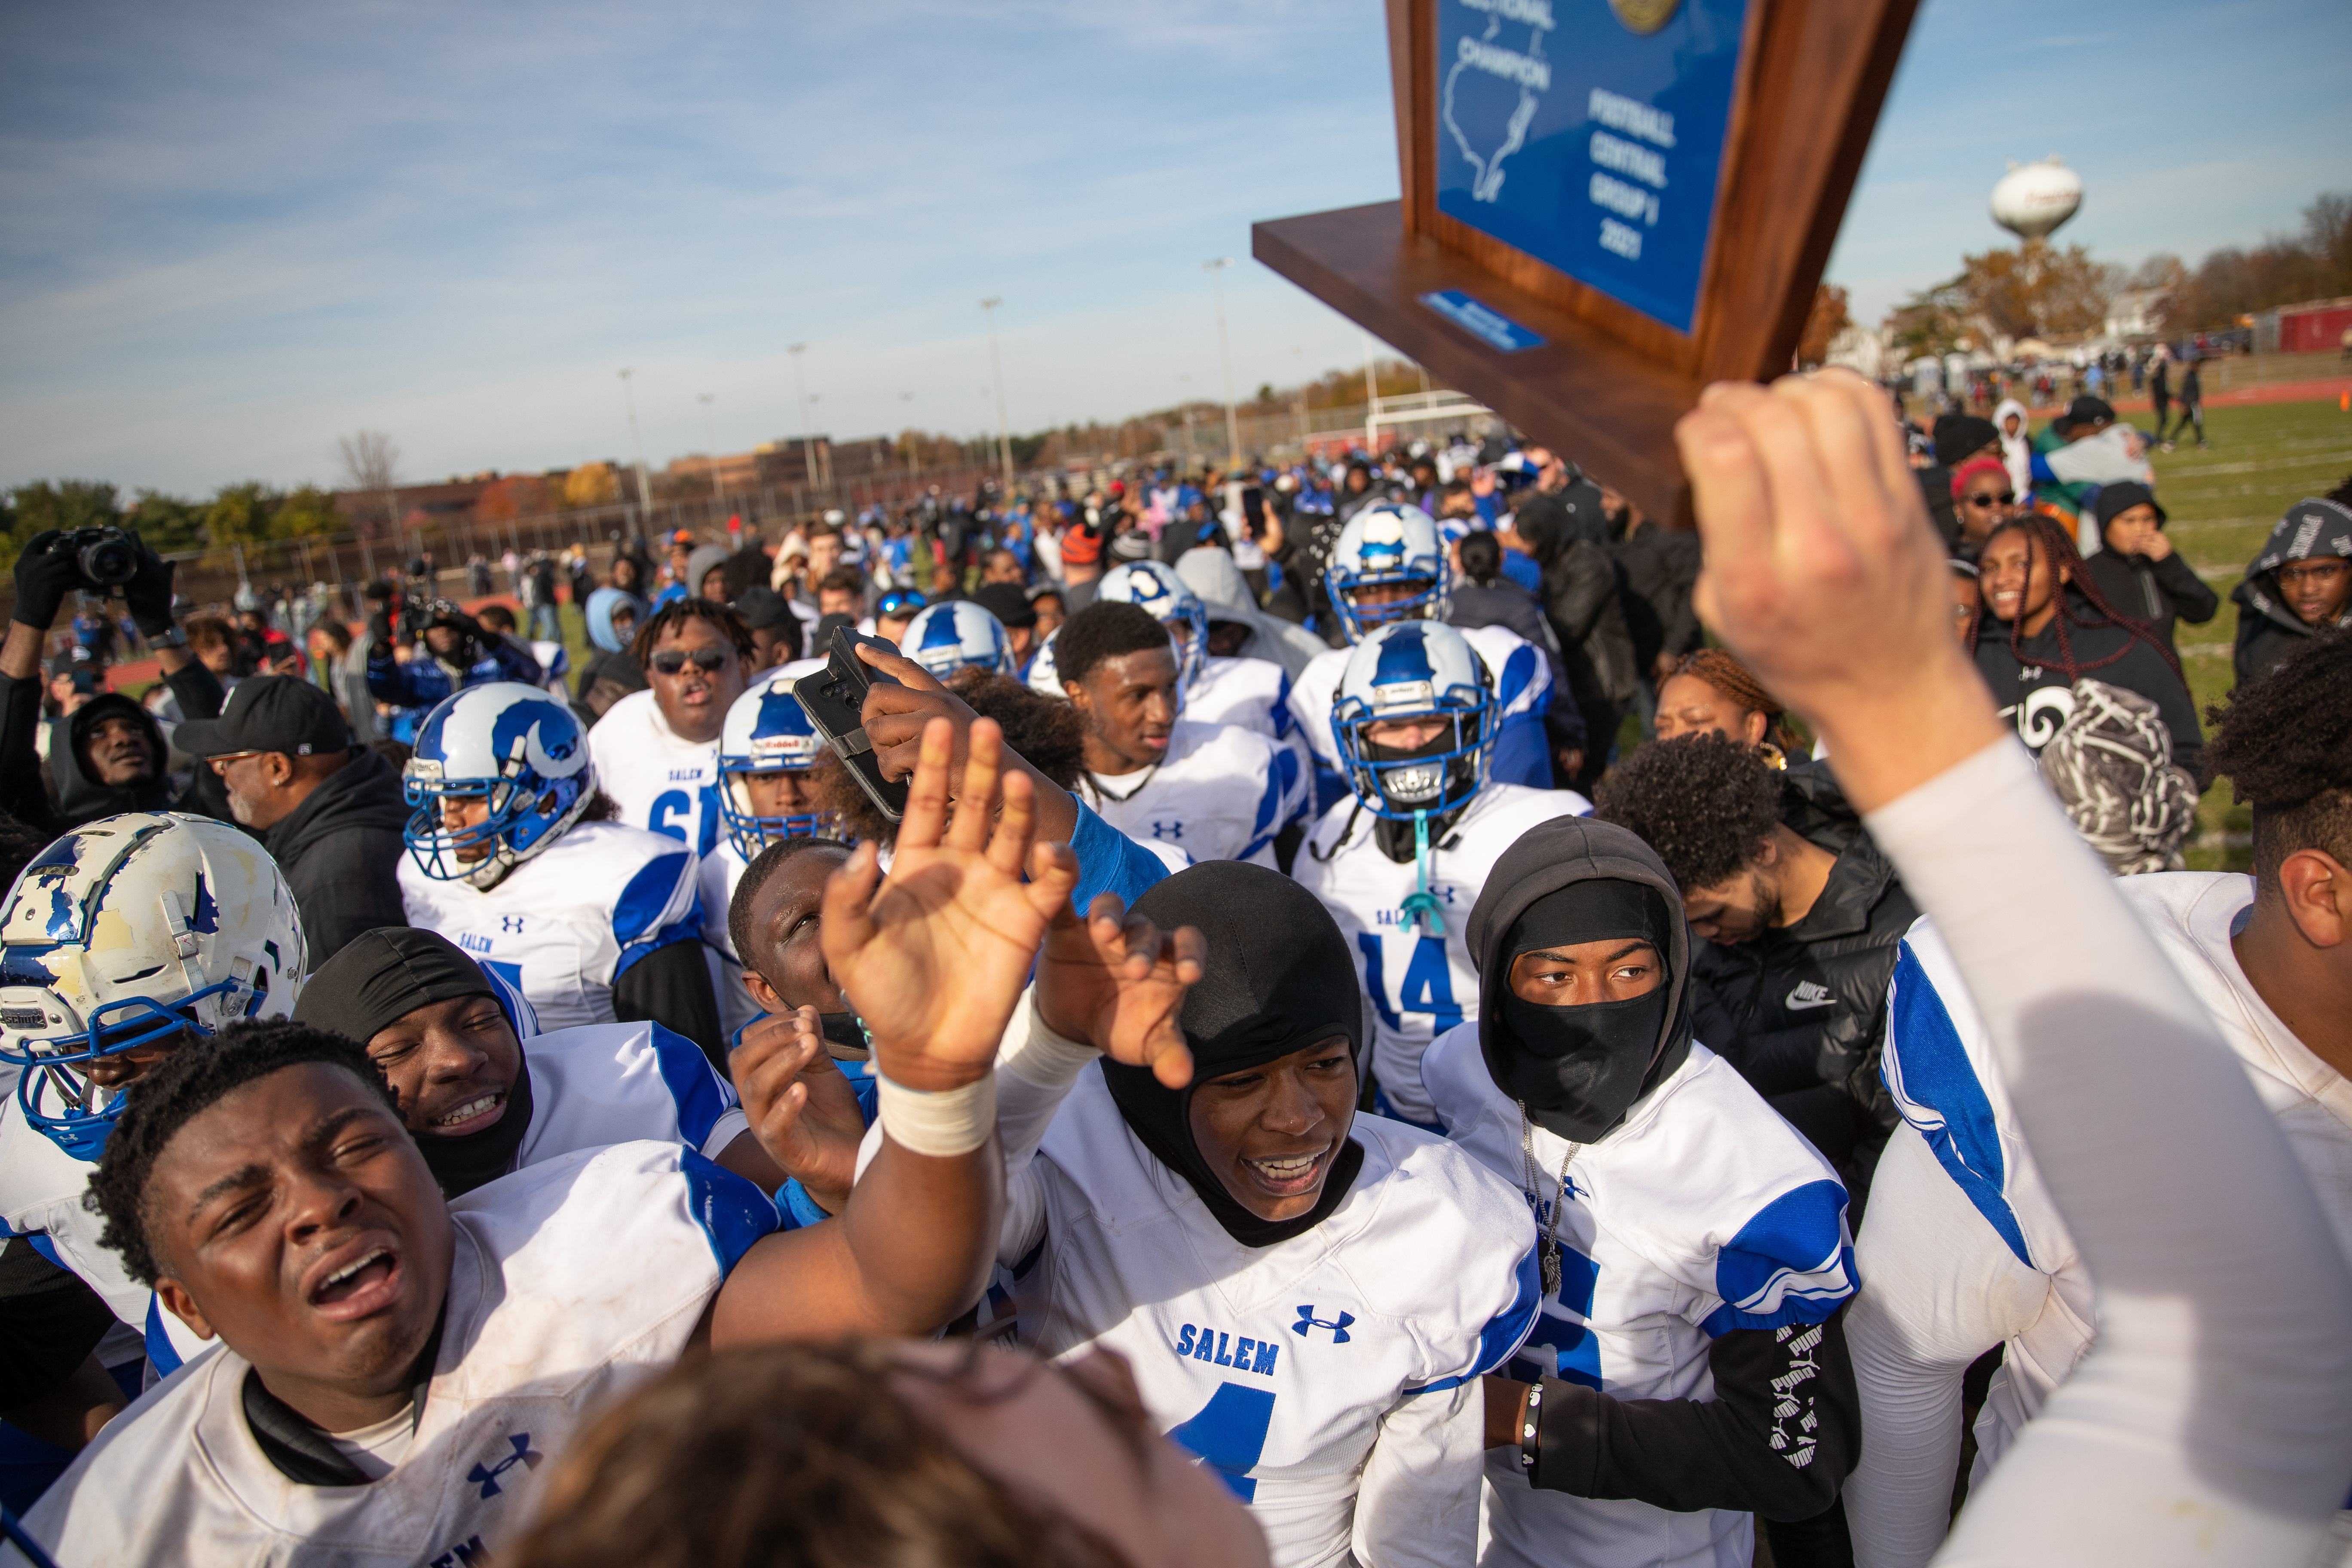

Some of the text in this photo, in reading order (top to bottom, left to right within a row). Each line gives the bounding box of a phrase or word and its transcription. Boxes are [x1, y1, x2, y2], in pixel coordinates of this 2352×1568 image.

[1458, 36, 1551, 92] CHAMPION
[1588, 87, 1676, 149] FOOTBALL
[1590, 130, 1668, 189] CENTRAL
[1589, 172, 1648, 220] GROUP
[1599, 217, 1642, 261] 2021
[669, 768, 702, 781] SALEM
[459, 932, 493, 953] SALEM
[1357, 931, 1464, 1037] 14
[1796, 980, 1828, 1001] NIKE
[1176, 1323, 1279, 1376] SALEM
[1770, 1366, 1816, 1392] PUMA
